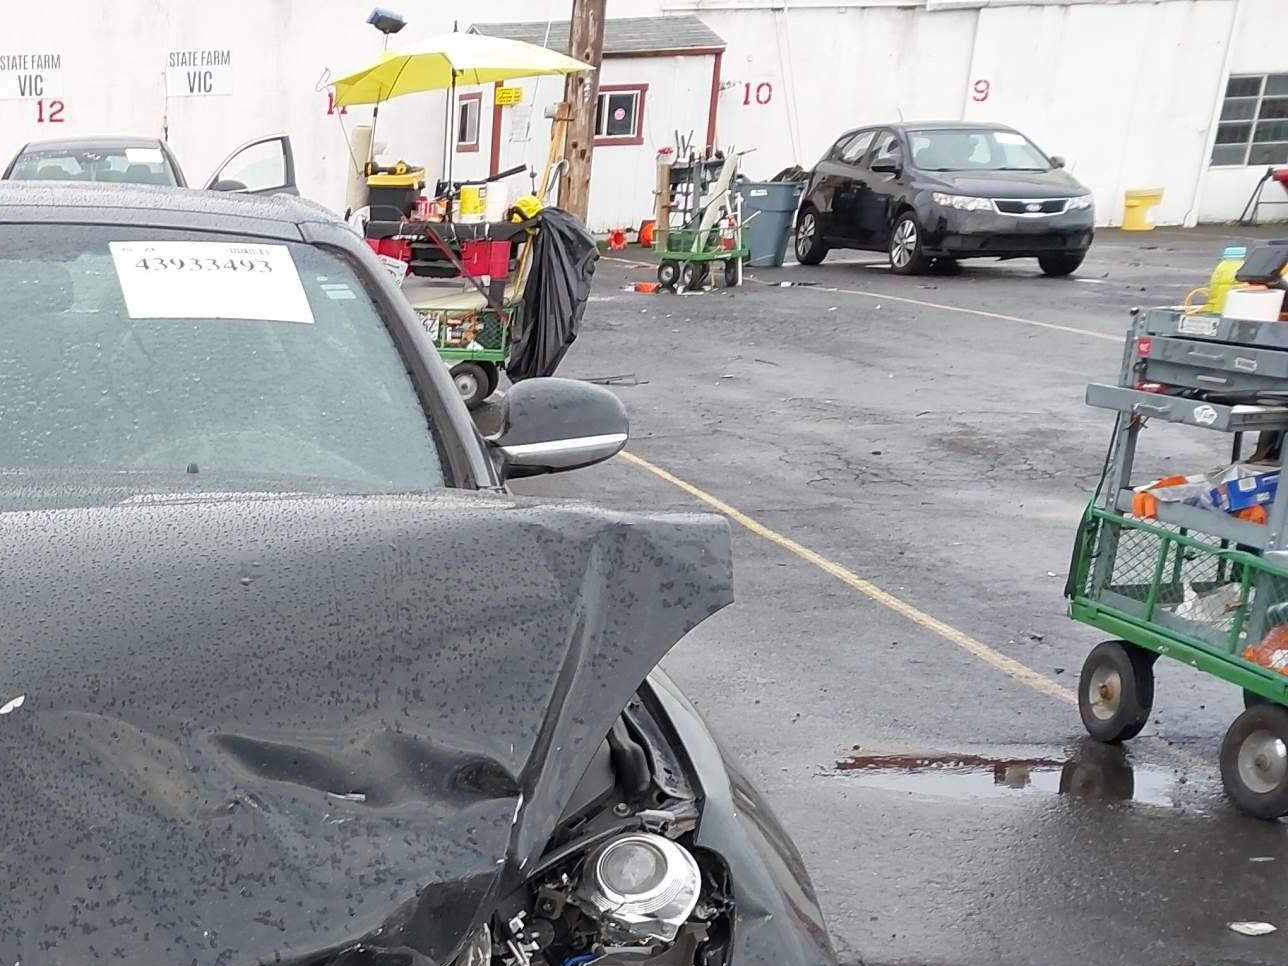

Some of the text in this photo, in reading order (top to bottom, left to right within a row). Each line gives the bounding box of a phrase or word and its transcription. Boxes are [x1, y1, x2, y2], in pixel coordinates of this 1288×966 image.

[0, 53, 61, 71] STATE FARM
[169, 50, 231, 68] STATE FARM
[17, 74, 44, 97] VIC
[187, 71, 213, 94] VIC
[743, 82, 773, 106] 10
[972, 79, 990, 102] 9
[37, 99, 65, 123] 12
[135, 257, 273, 273] 43933493
